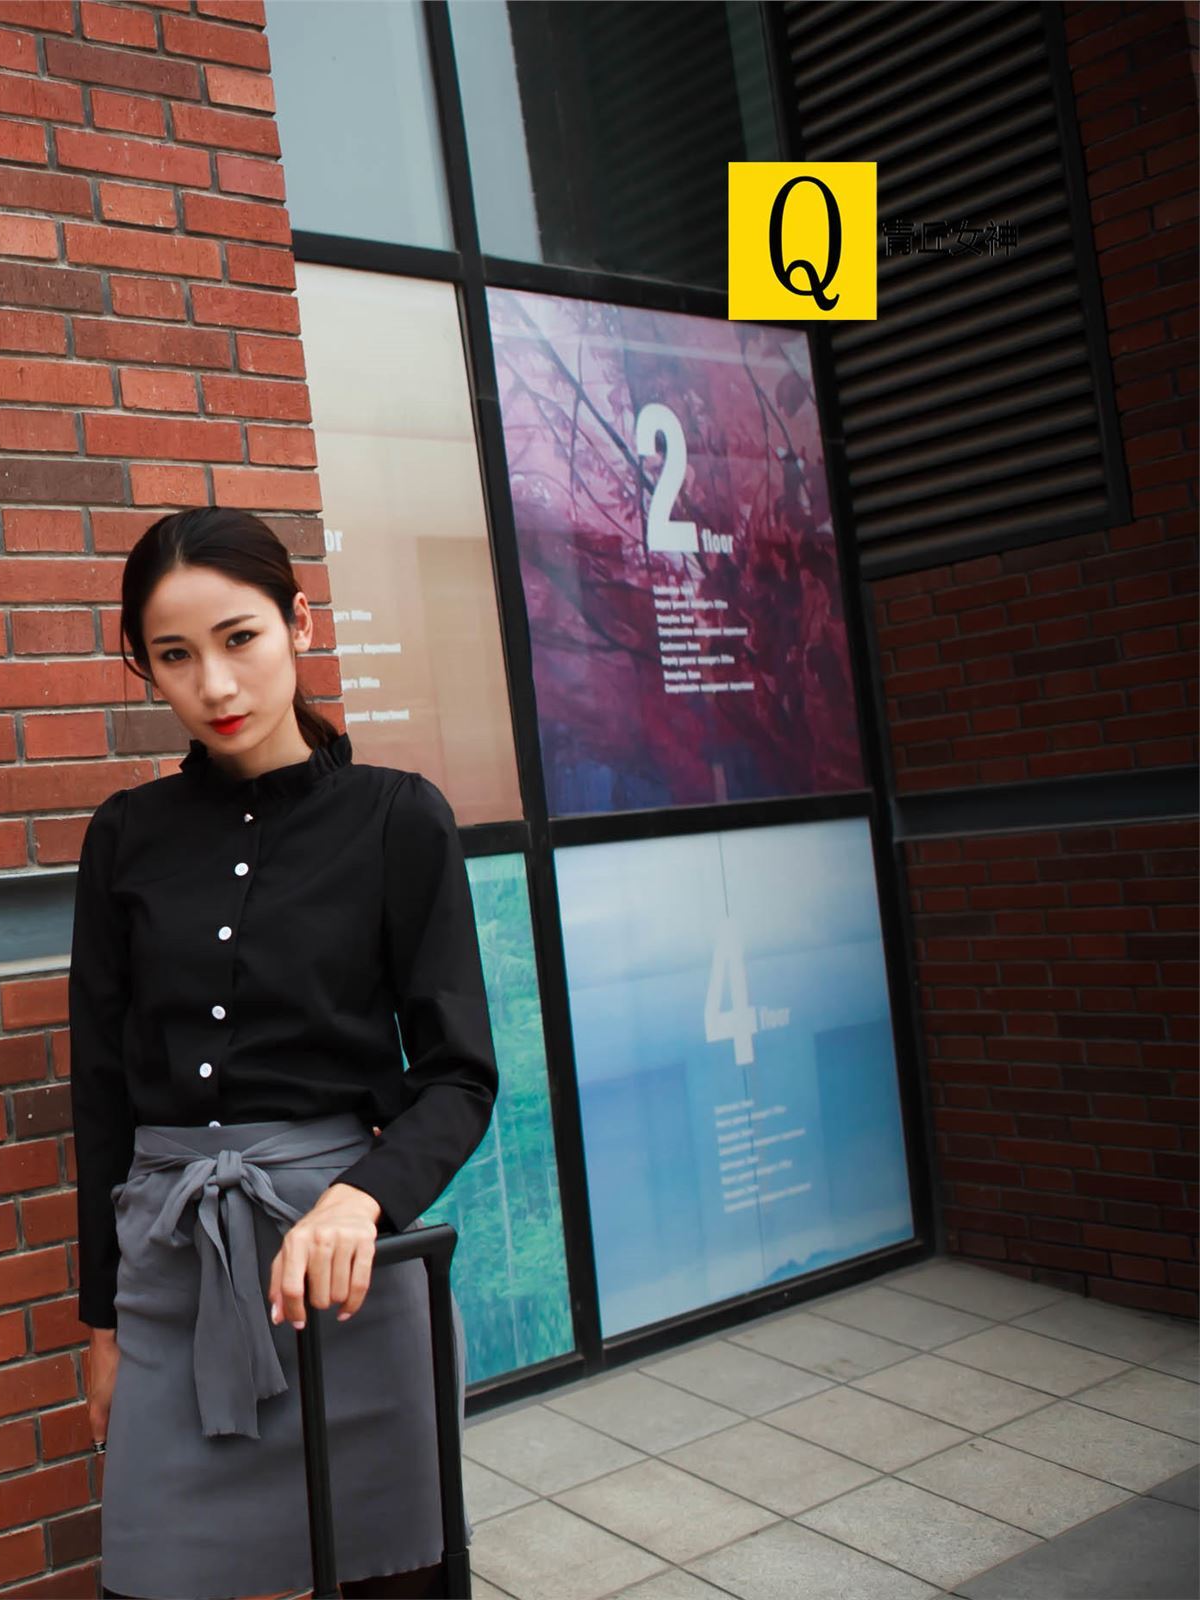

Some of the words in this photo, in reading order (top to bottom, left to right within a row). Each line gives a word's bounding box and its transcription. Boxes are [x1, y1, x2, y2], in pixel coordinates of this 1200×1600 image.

[636, 402, 699, 552] 2
[701, 528, 734, 554] floor
[704, 918, 758, 1065] 4
